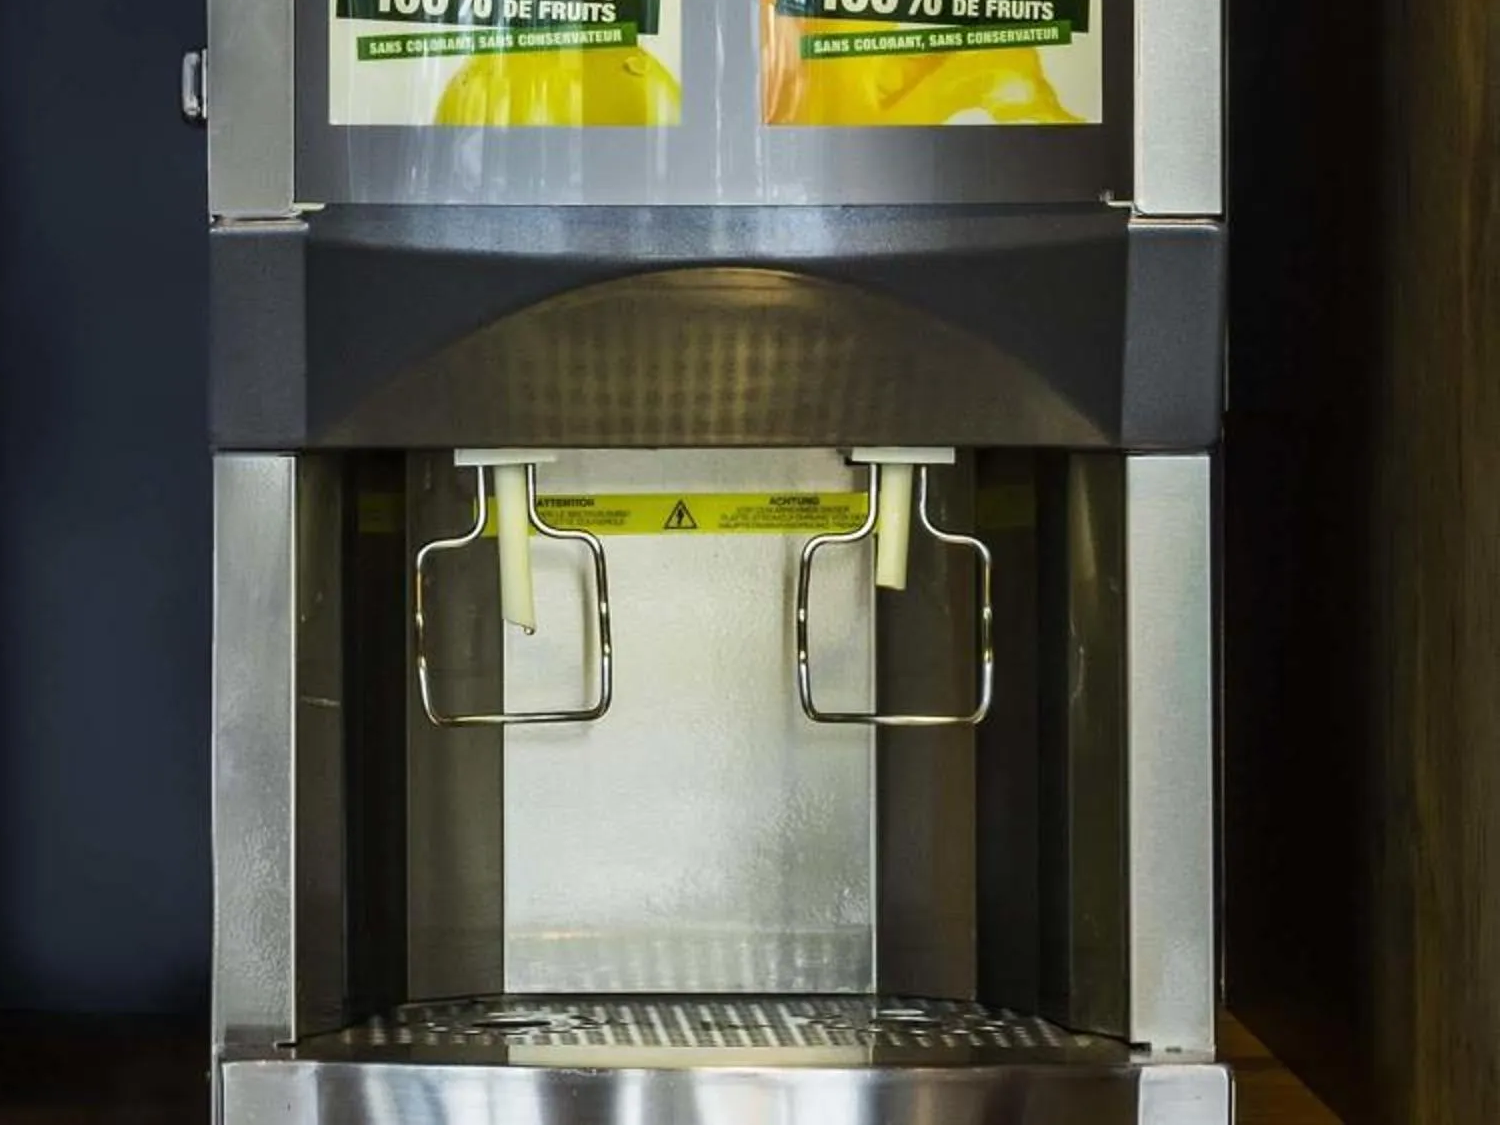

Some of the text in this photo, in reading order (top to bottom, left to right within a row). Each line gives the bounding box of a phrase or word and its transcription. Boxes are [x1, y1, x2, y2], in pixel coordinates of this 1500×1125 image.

[539, 0, 617, 22] FRUITS
[369, 39, 402, 56] SANS
[479, 32, 514, 49] SANS
[518, 28, 622, 48] CONSERVATEUR
[813, 38, 850, 54] SANS
[929, 31, 963, 48] SANS
[967, 26, 1059, 46] CONSERVATEUR
